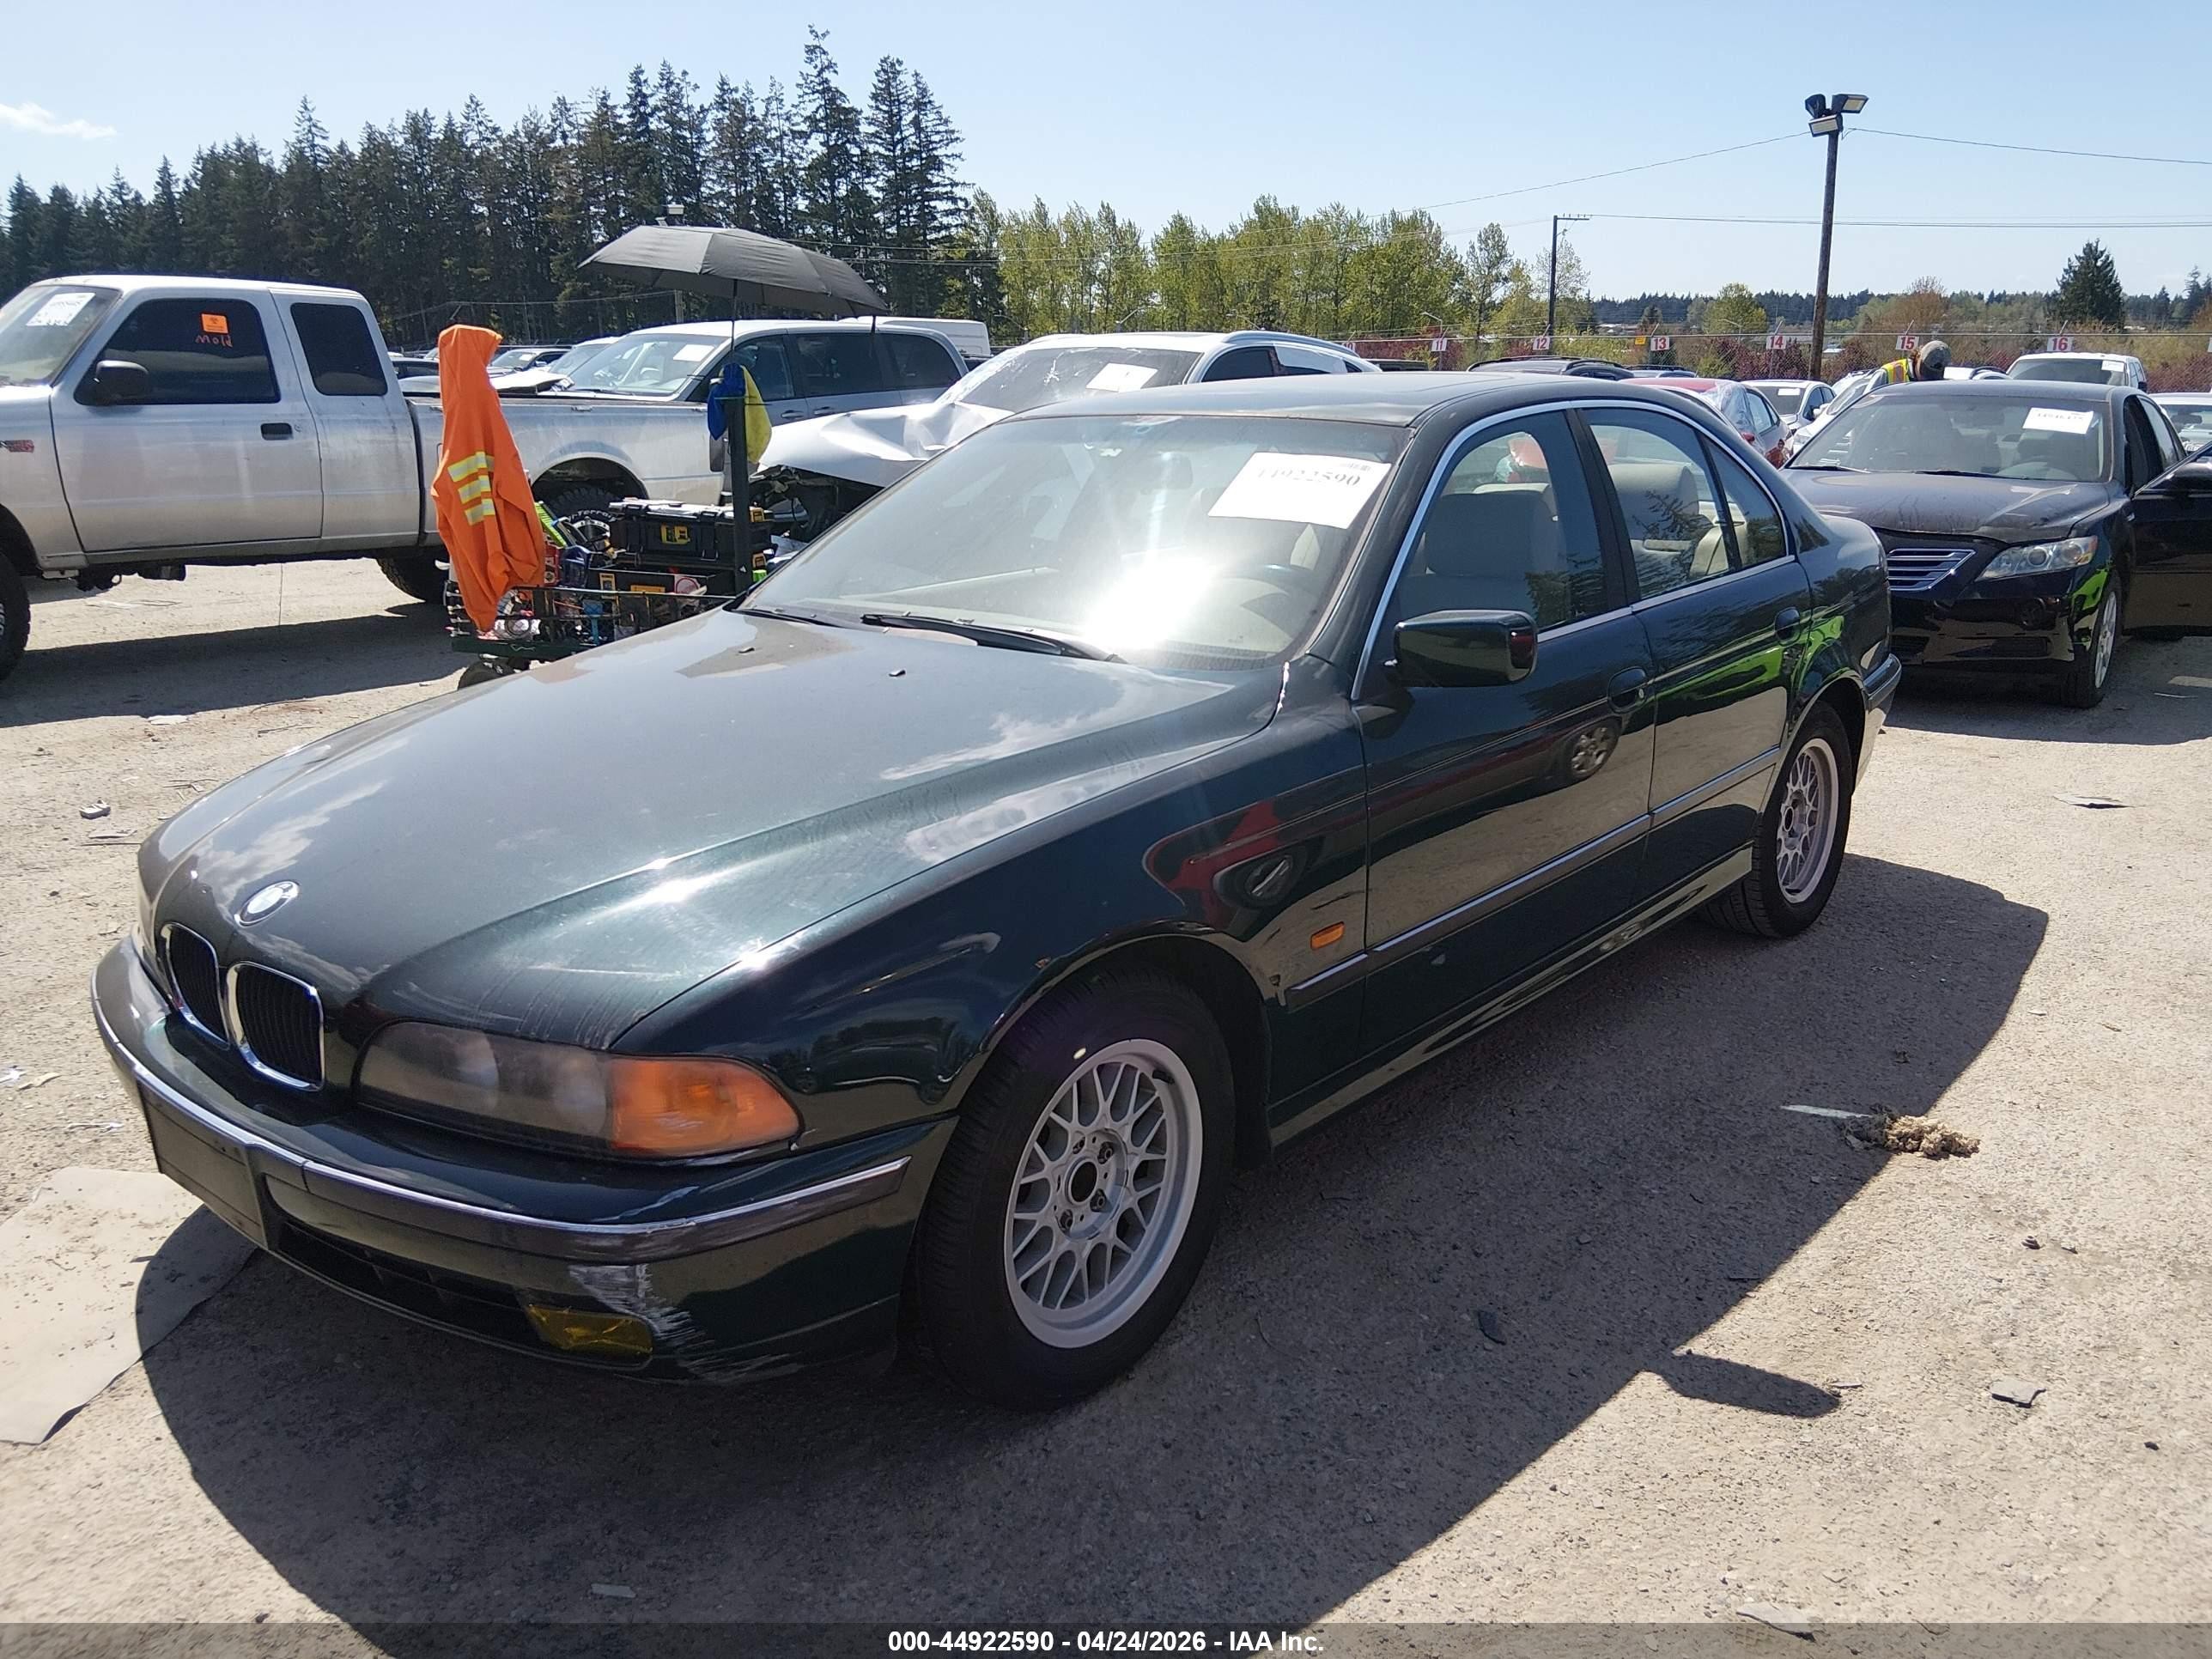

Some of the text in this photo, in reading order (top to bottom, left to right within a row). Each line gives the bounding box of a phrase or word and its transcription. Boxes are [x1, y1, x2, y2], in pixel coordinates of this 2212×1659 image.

[1436, 340, 1443, 350] 11
[1536, 337, 1547, 349] 12
[1654, 337, 1667, 349] 13
[1770, 336, 1784, 348] 14
[1900, 337, 1915, 349] 15
[2052, 337, 2069, 350] 16
